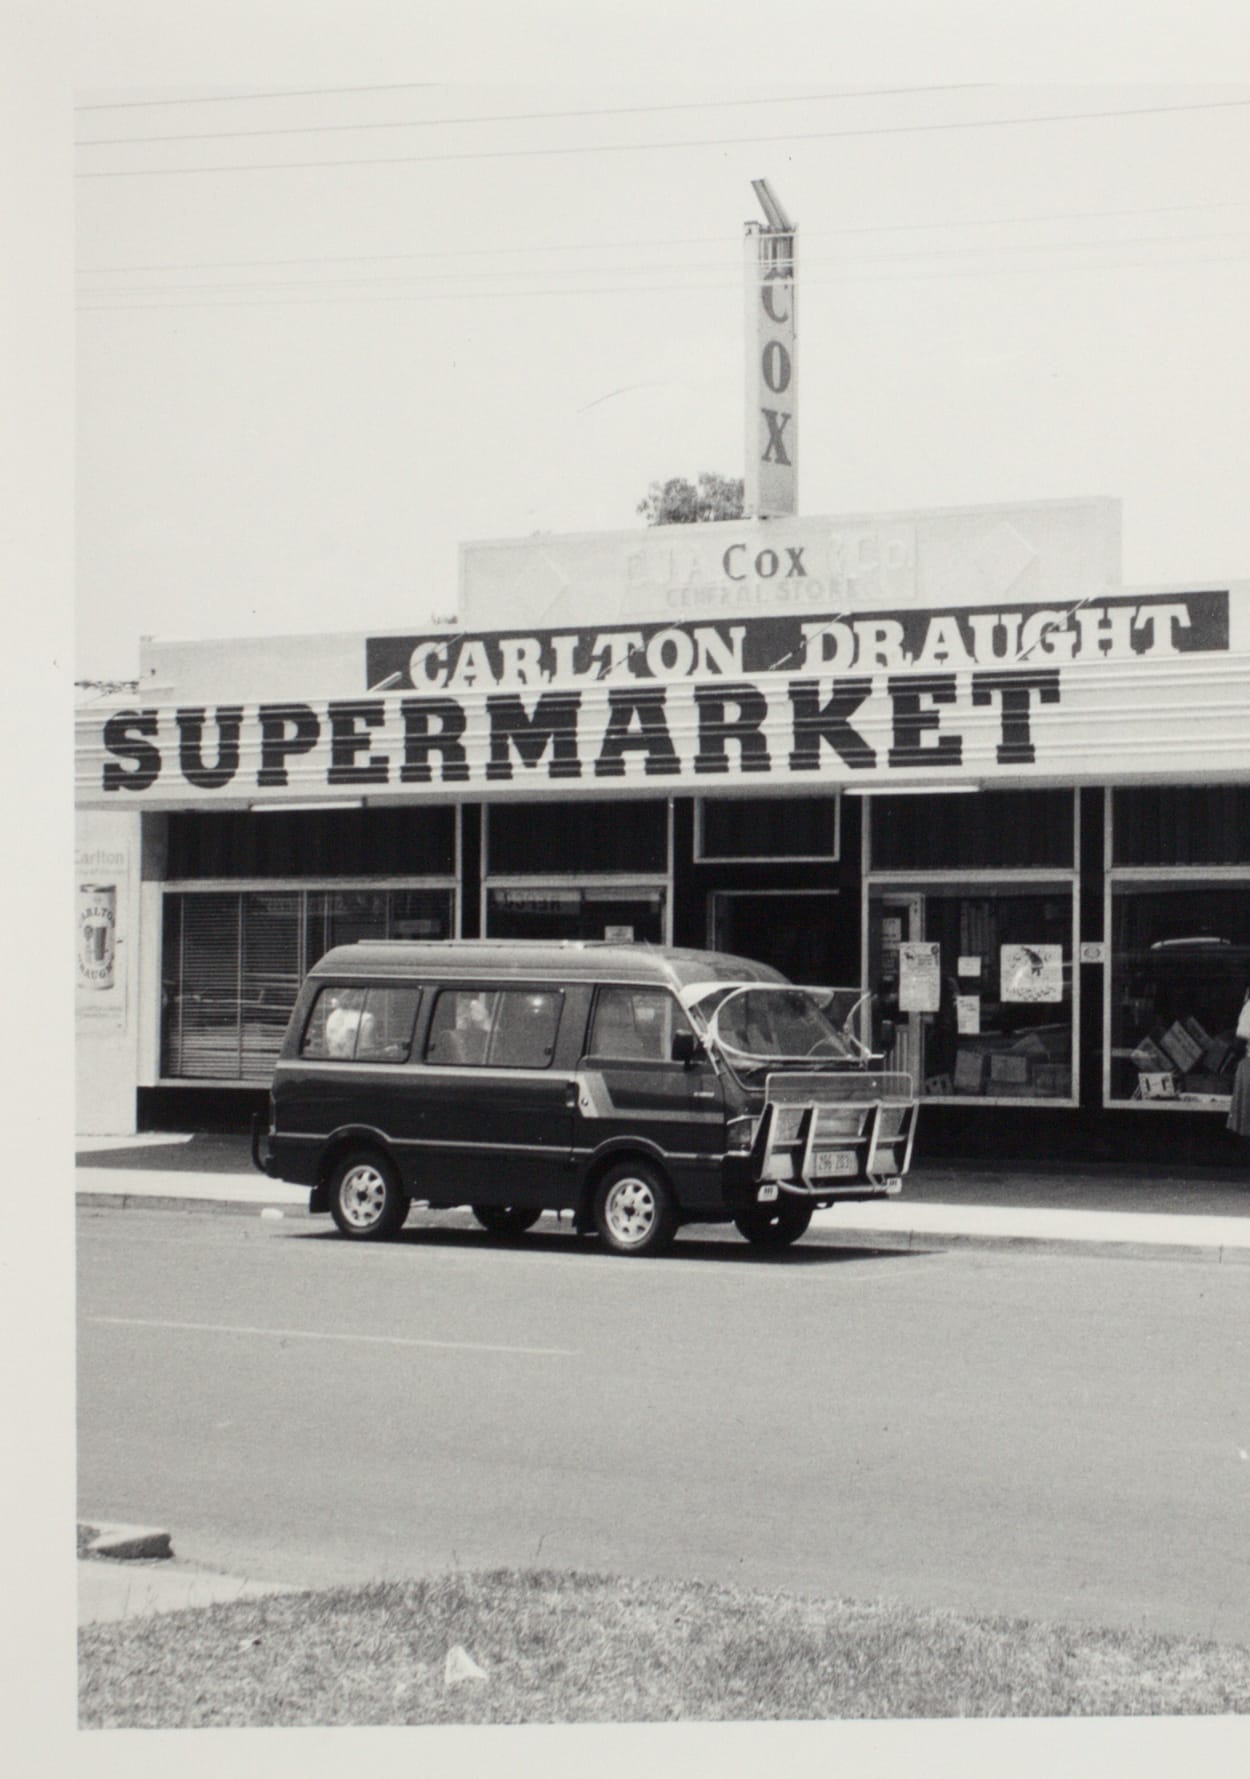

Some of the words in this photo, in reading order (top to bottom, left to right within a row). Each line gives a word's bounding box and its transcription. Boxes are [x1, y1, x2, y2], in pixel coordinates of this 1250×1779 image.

[760, 267, 792, 467] COX
[408, 625, 747, 691] CARLTON
[799, 603, 1192, 671] DRAUGHT
[101, 669, 1061, 792] SUPERMARKET
